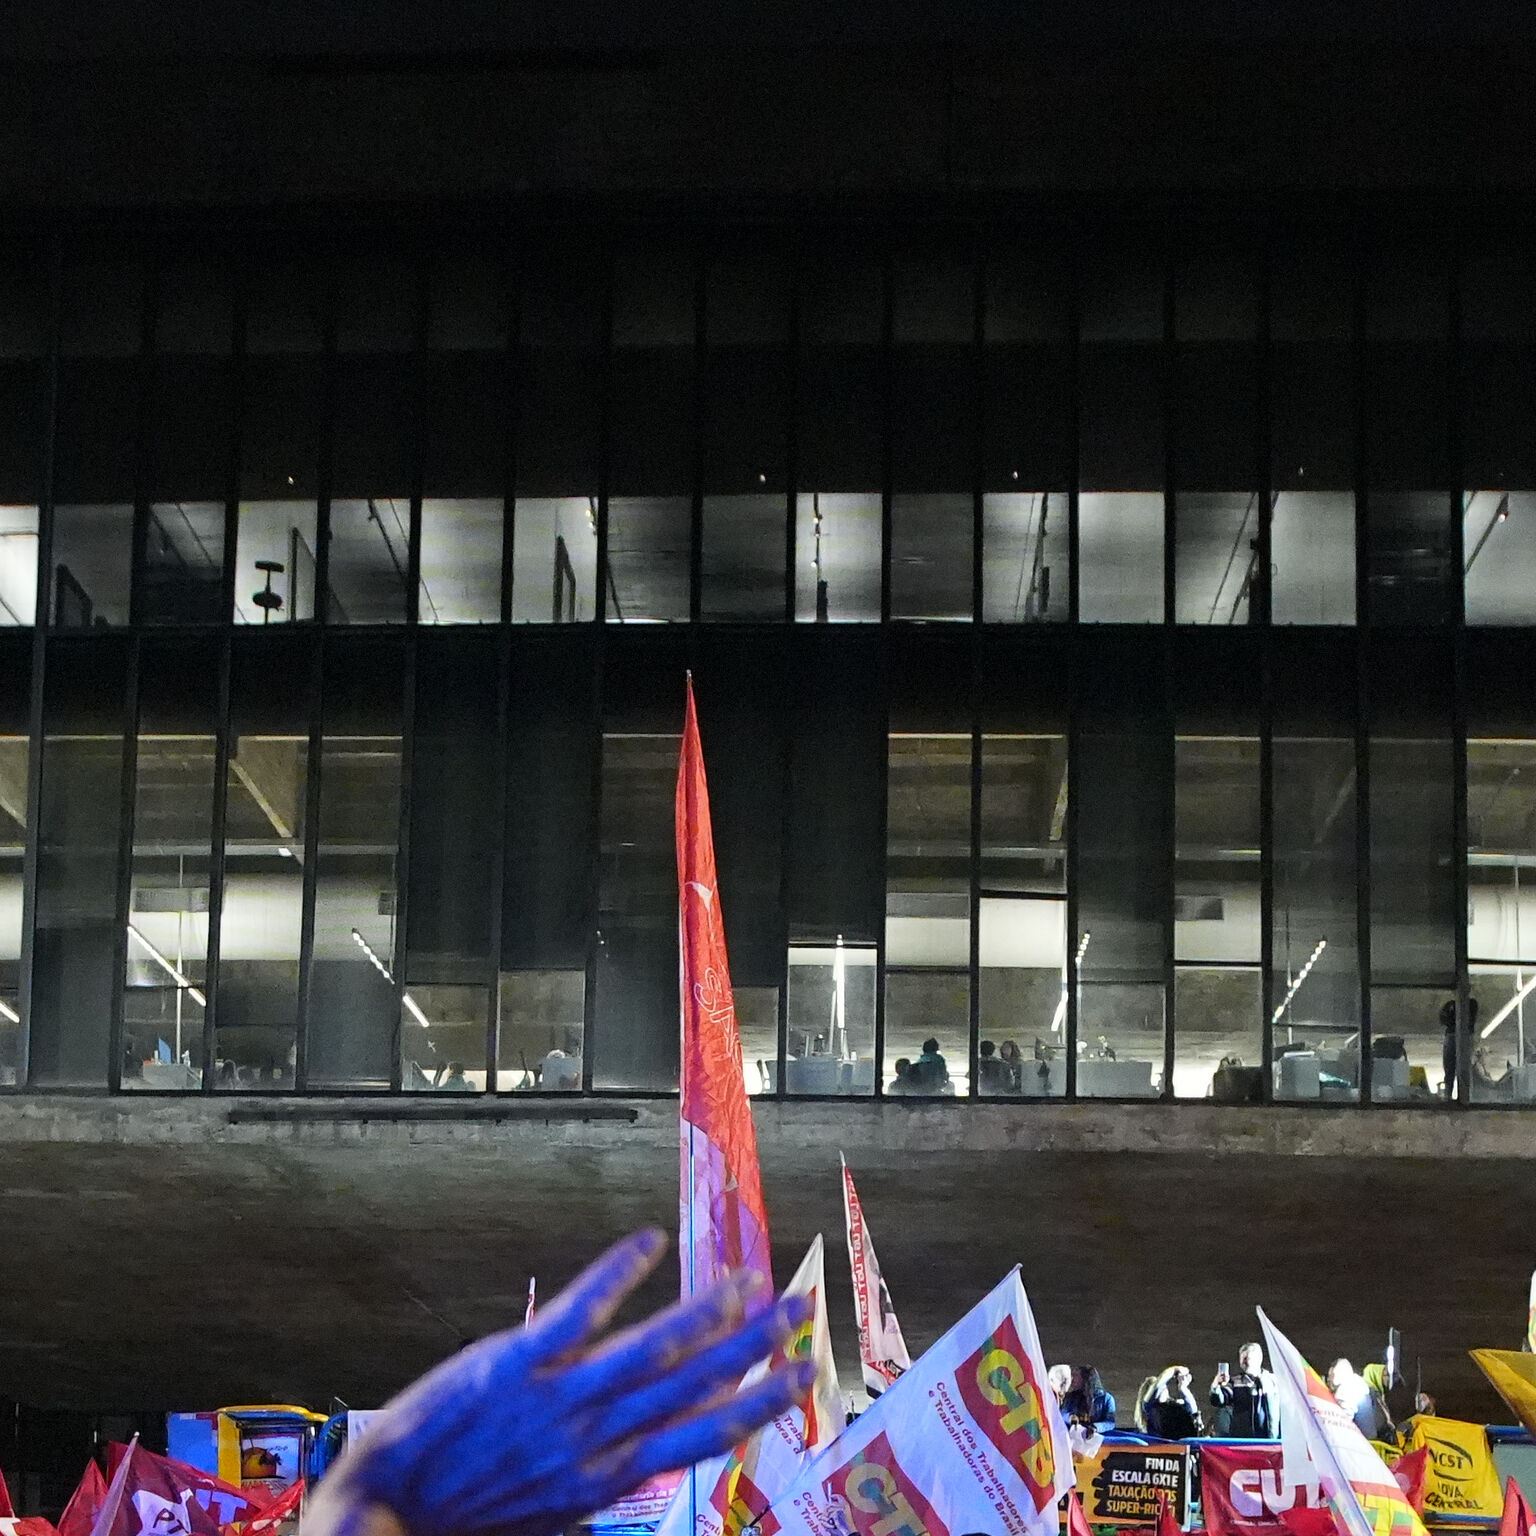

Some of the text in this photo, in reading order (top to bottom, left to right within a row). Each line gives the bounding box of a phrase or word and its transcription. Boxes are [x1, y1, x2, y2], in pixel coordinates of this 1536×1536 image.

[976, 1348, 1056, 1489] CTB
[928, 1389, 1021, 1536] e Trabalhadoras do Brasil
[936, 1381, 1029, 1534] Central dos Trabalhadores
[1145, 1457, 1180, 1473] FIM DA
[1108, 1485, 1155, 1501] TAXAÇÃO
[1112, 1470, 1179, 1488] ESCALA 6X1 E
[802, 1491, 825, 1525] Cent
